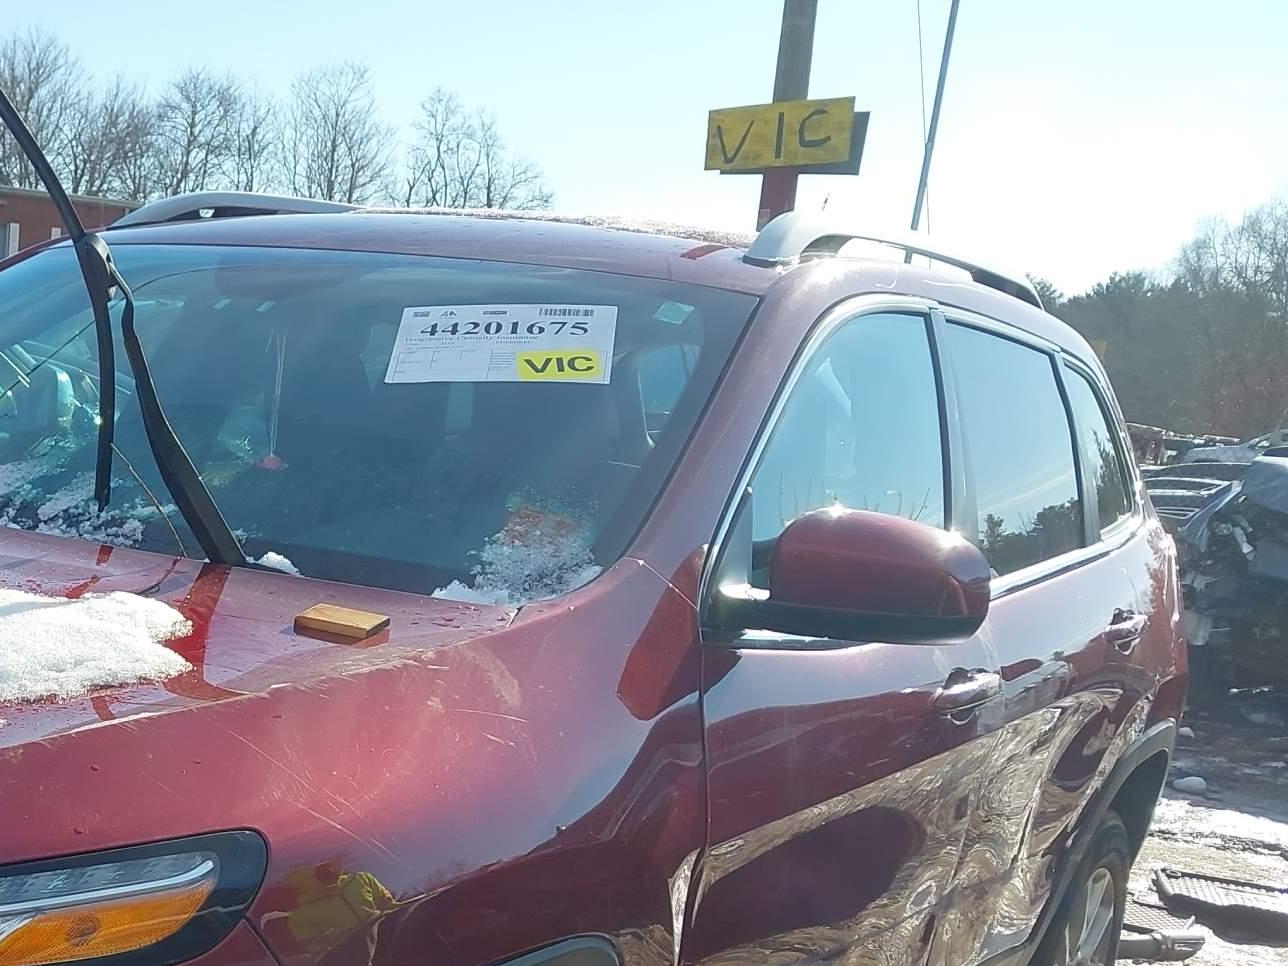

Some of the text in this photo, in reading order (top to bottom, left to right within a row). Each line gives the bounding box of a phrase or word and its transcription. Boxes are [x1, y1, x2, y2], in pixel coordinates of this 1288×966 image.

[716, 108, 832, 165] VIC
[419, 320, 590, 337] 44201675
[523, 355, 595, 374] VIC
